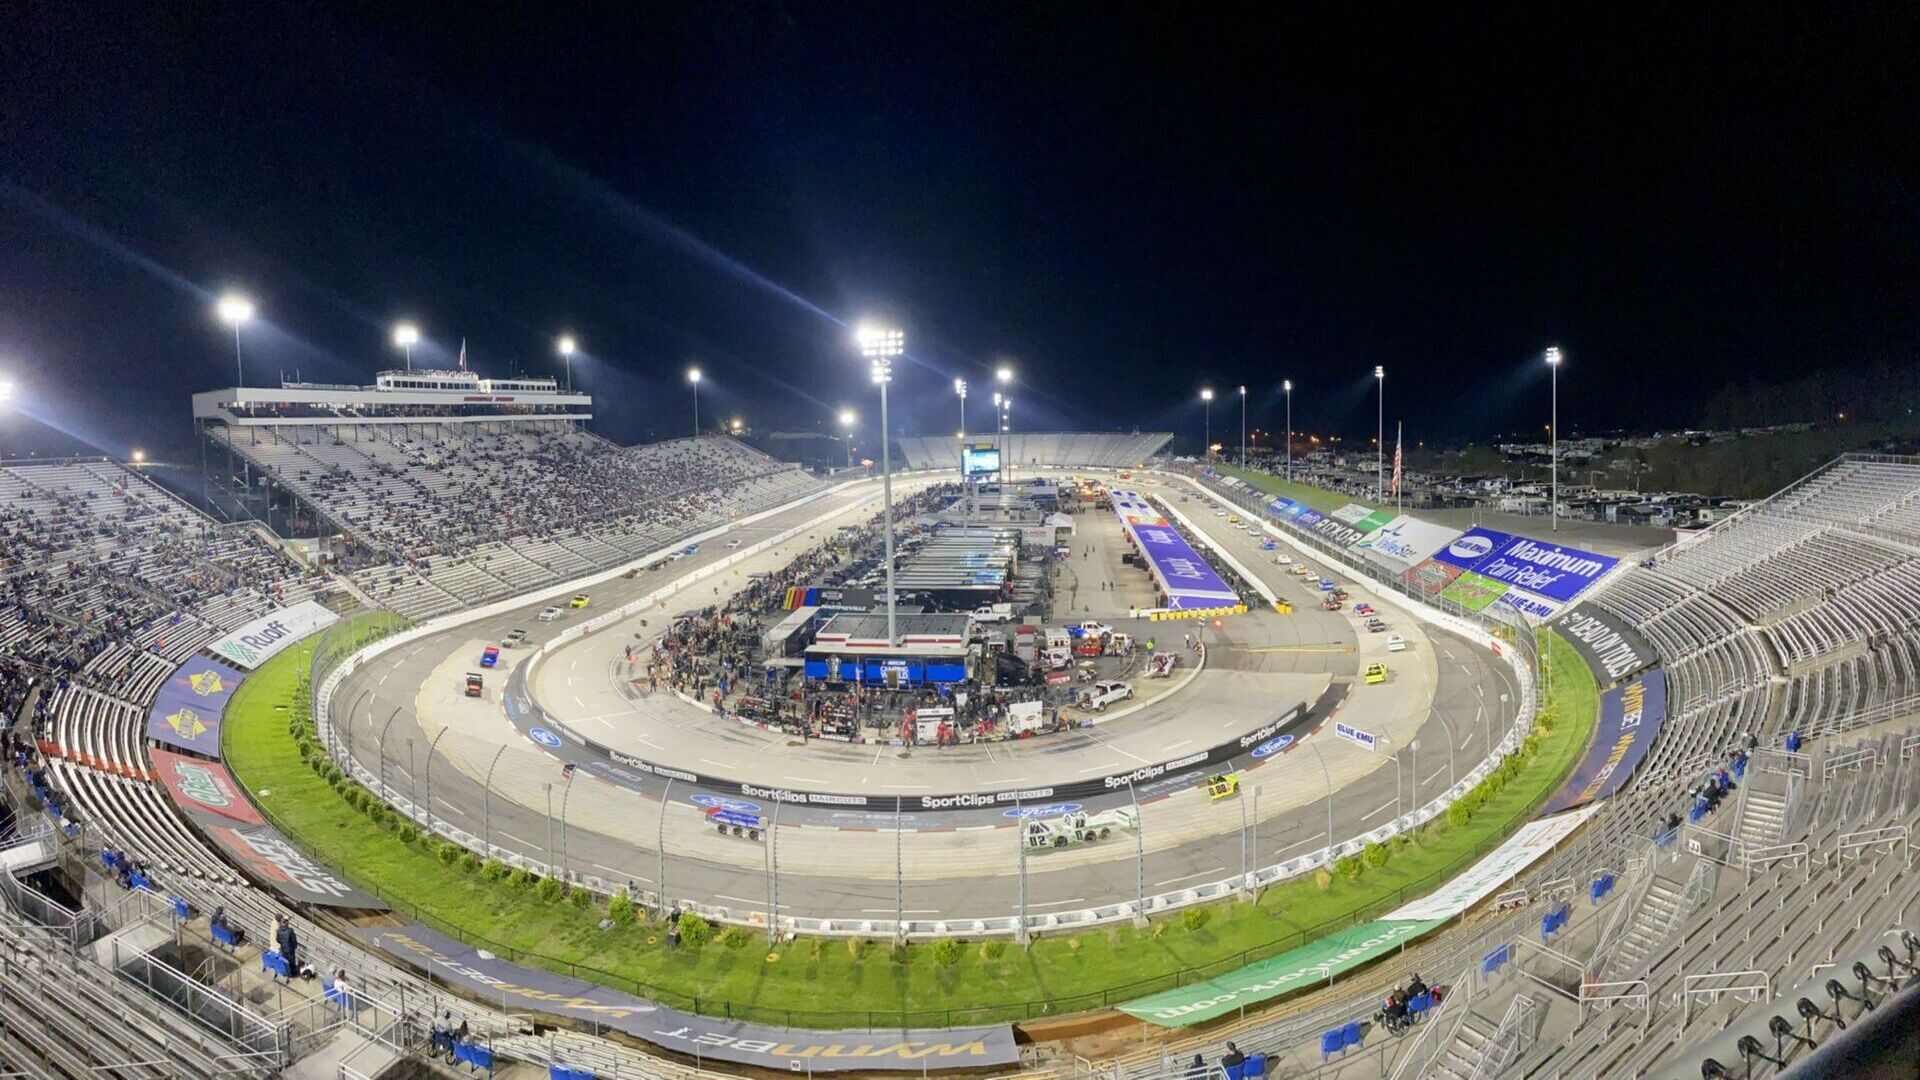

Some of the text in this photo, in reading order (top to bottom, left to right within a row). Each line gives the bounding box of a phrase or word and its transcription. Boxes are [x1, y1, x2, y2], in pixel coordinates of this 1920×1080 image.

[1503, 539, 1603, 578] Maximum
[1481, 557, 1518, 581] Pain
[1512, 565, 1566, 590] Relief
[240, 620, 292, 650] Ruoff
[1568, 616, 1642, 679] DEAD ON TOOLS
[1240, 724, 1277, 748] SportClips
[1104, 763, 1165, 789] SportClips
[741, 783, 808, 804] SportClips
[921, 793, 995, 809] SportClips
